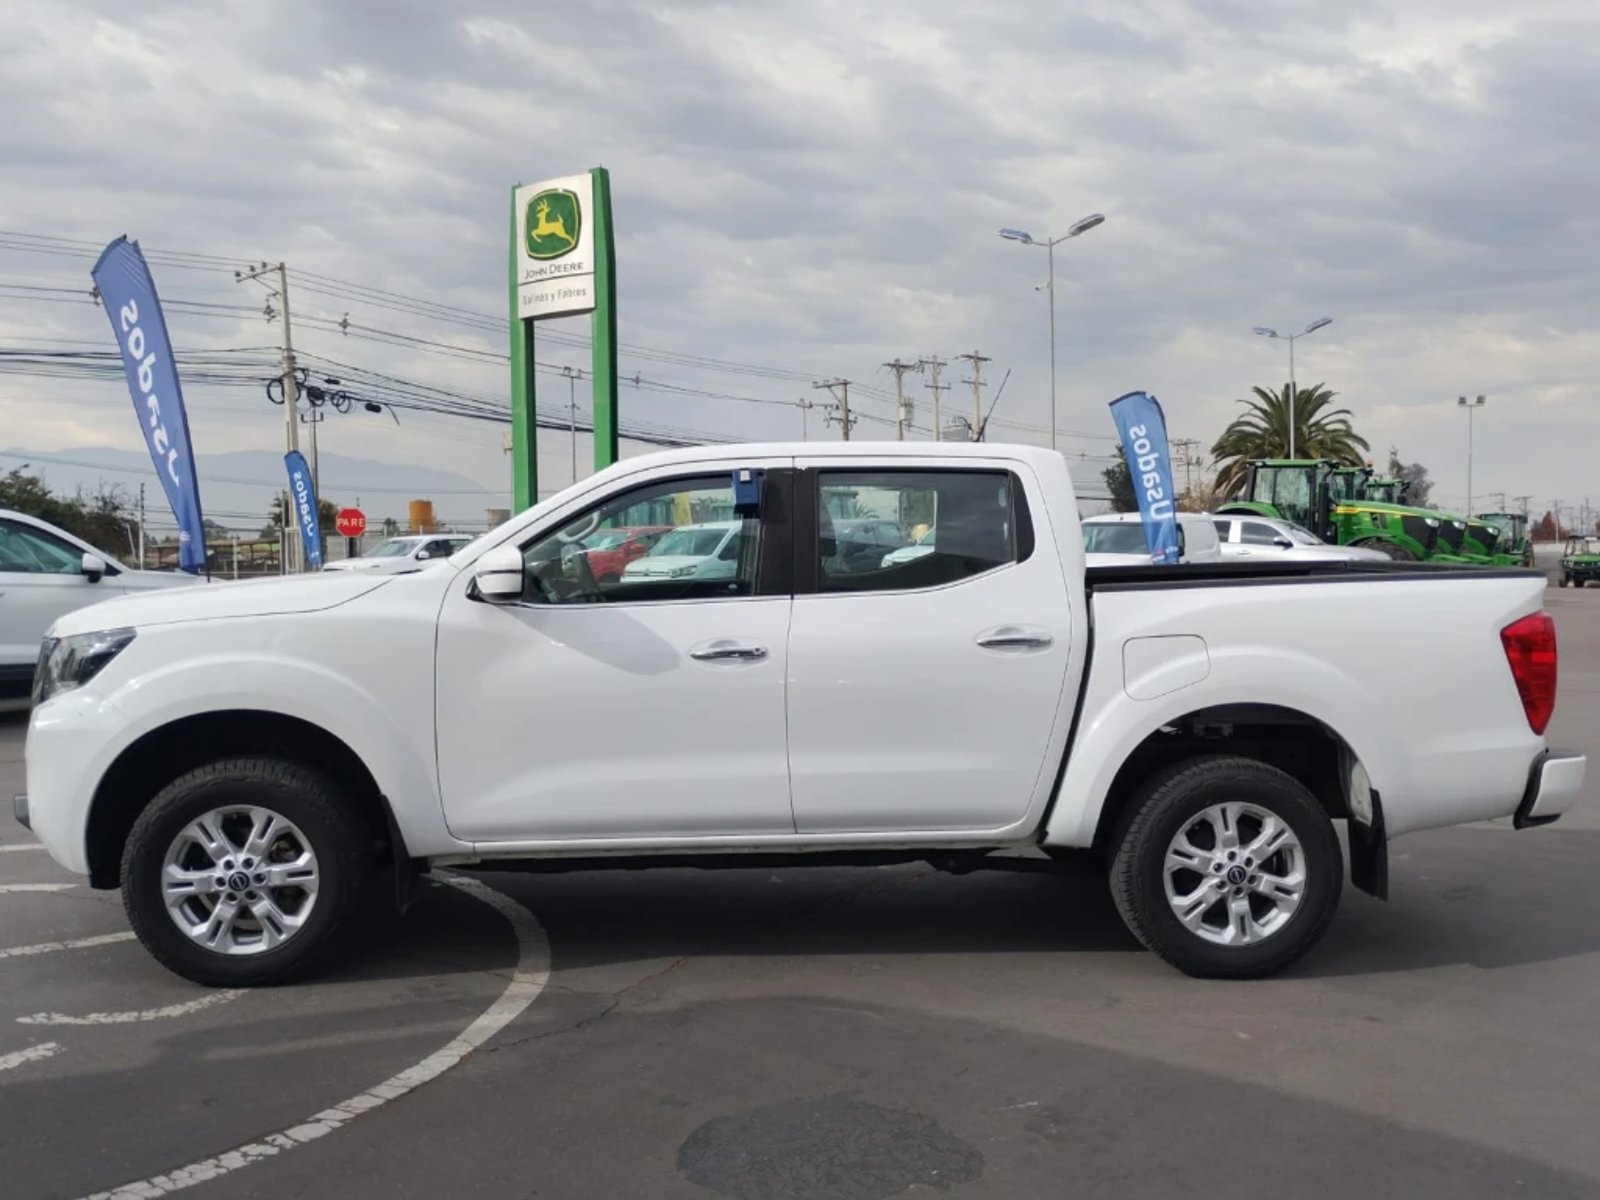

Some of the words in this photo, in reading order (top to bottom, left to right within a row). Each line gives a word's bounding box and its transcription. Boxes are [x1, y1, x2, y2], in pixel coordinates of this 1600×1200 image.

[524, 265, 548, 280] JOHN
[549, 262, 584, 275] DEERE
[336, 518, 366, 528] PARE
